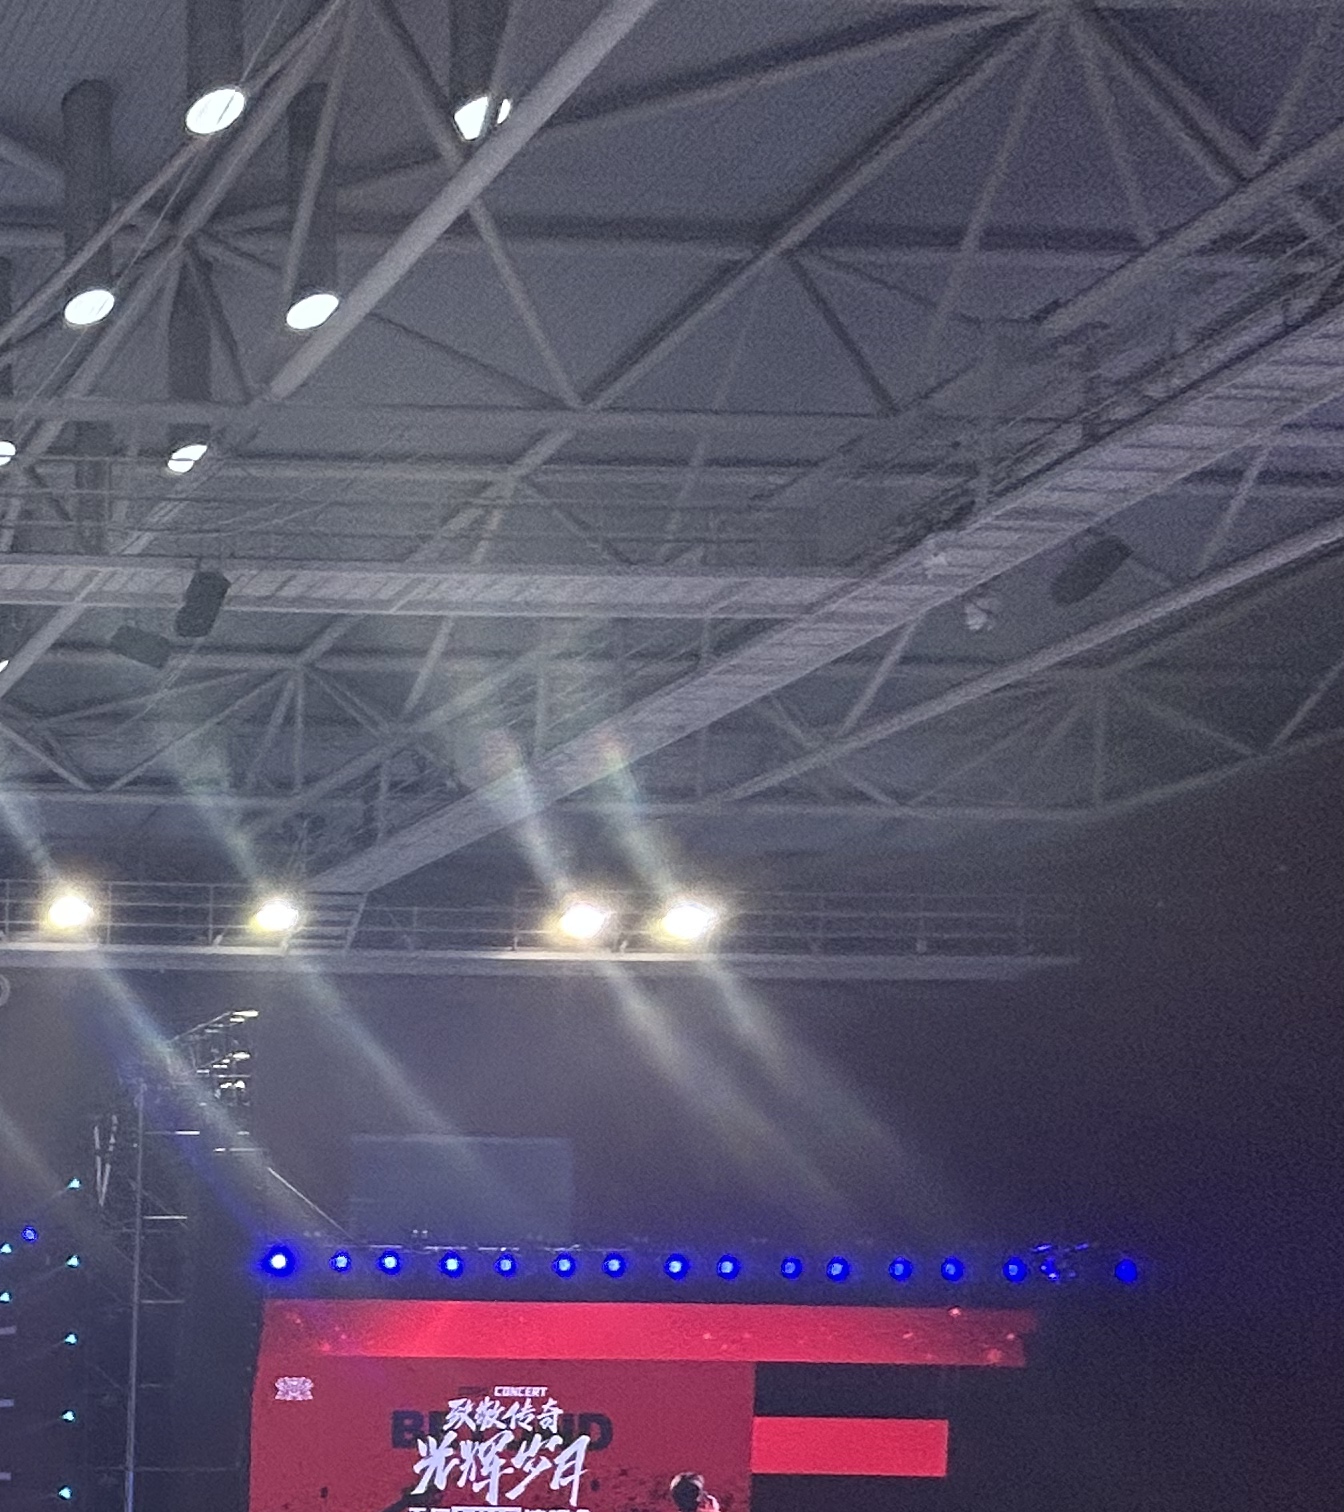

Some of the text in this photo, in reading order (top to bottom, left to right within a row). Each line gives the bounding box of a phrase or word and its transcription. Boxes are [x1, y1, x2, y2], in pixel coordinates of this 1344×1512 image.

[493, 1386, 548, 1397] CONCERT
[442, 1396, 564, 1433] 致敬传奇
[410, 1430, 591, 1507] 光辉岁月
